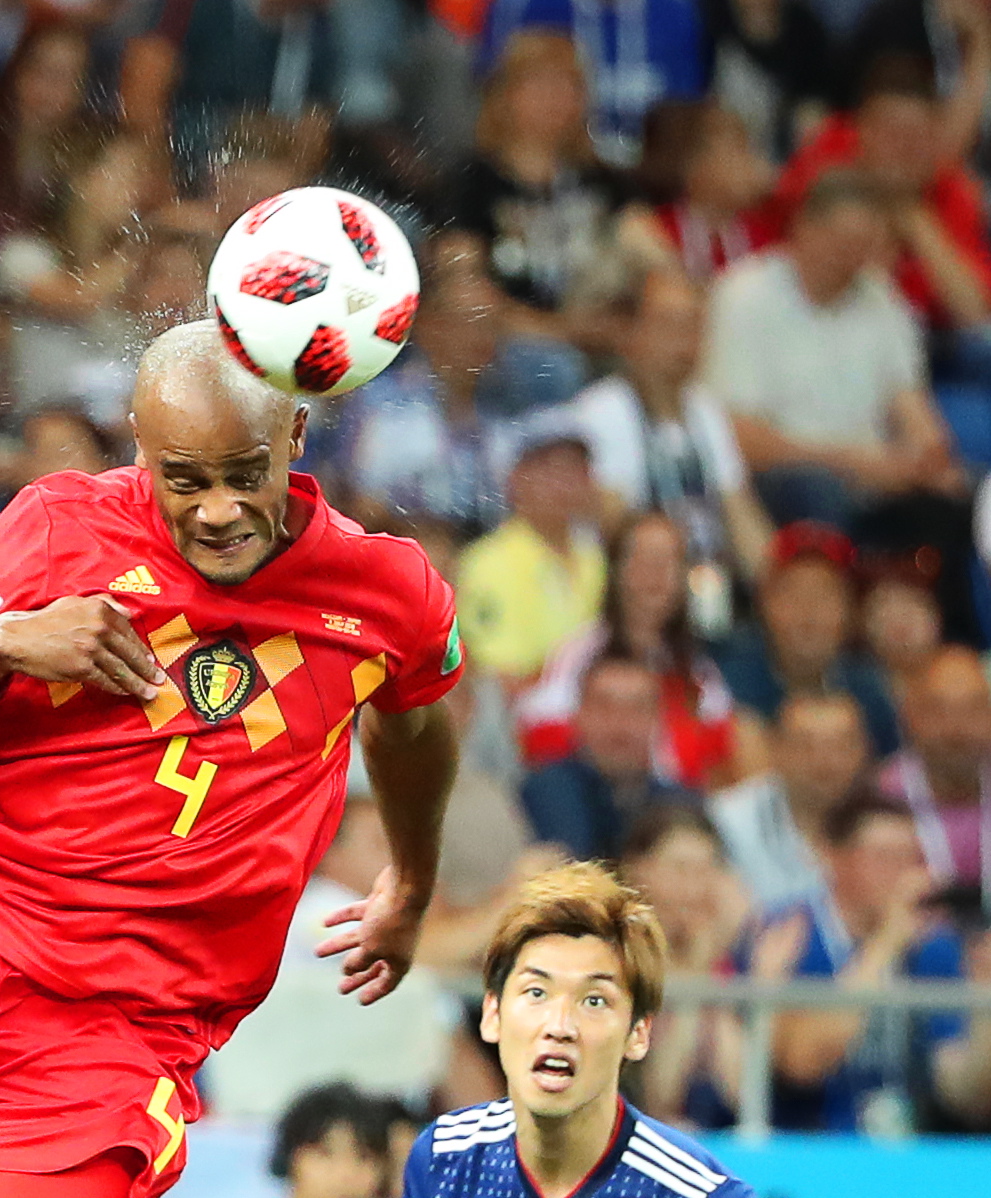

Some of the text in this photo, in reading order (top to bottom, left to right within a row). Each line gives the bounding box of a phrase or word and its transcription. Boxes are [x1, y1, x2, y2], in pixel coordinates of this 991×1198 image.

[108, 581, 161, 596] adidas
[154, 734, 219, 839] 4
[146, 1076, 186, 1175] 4
